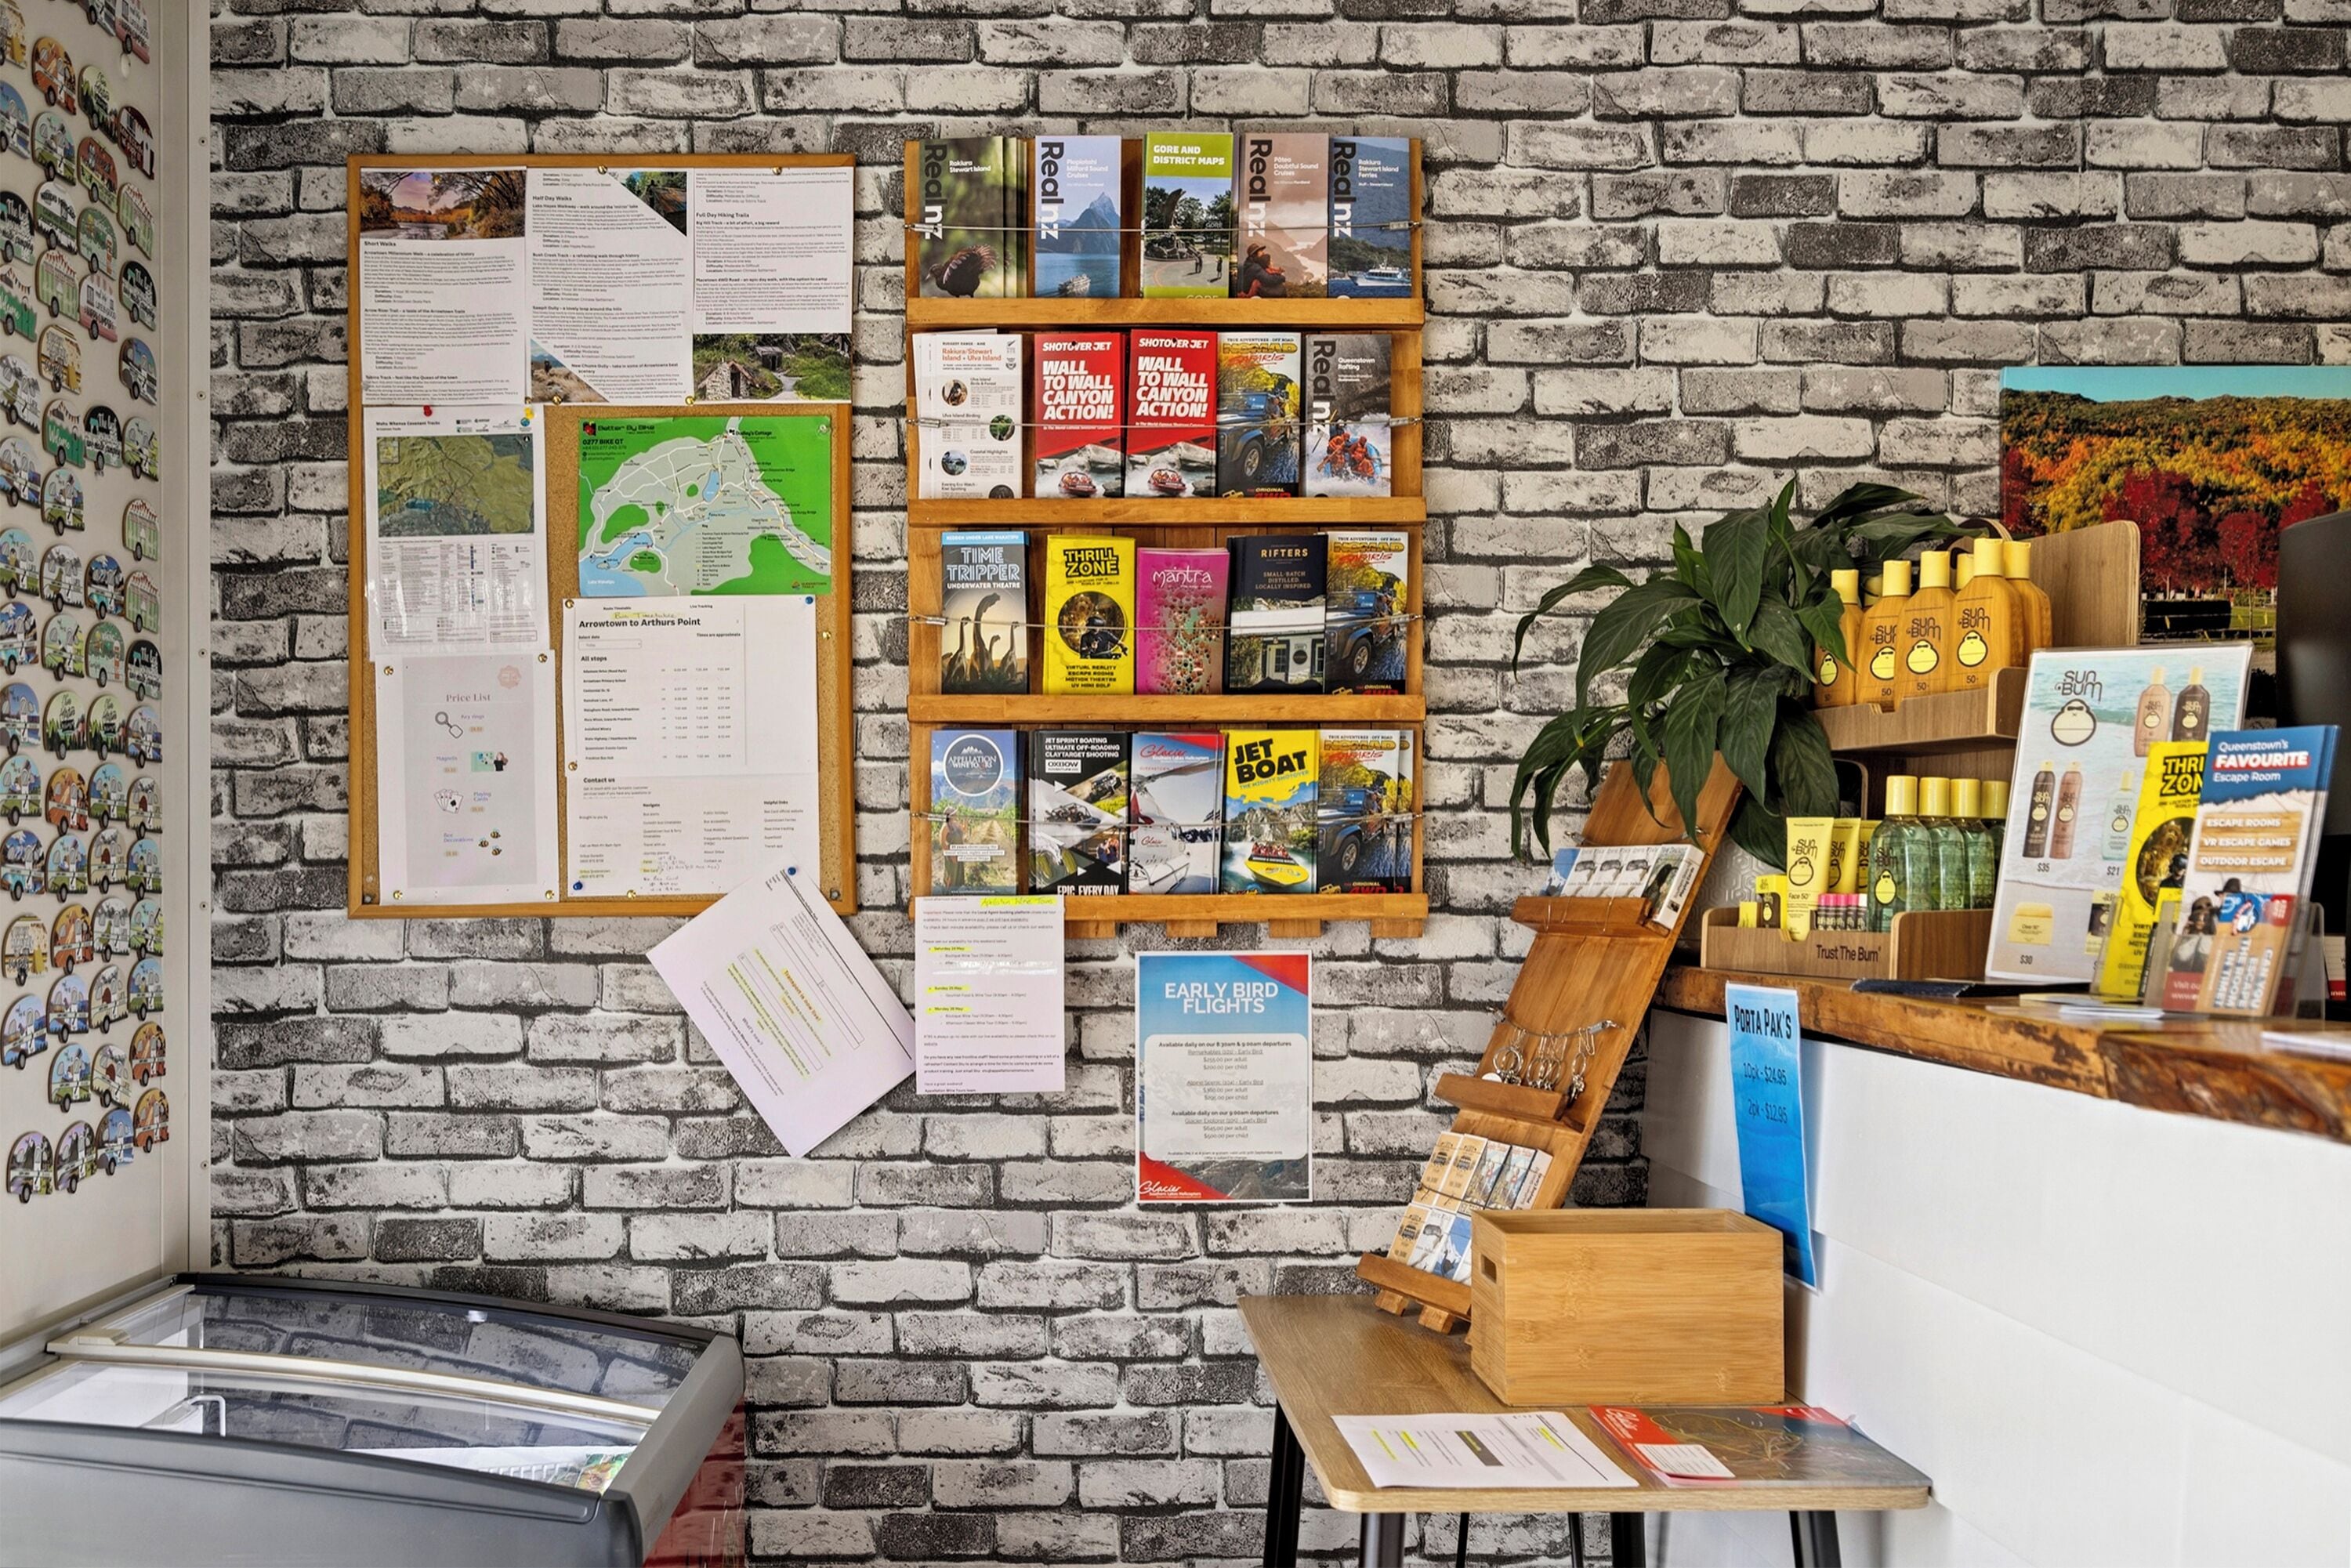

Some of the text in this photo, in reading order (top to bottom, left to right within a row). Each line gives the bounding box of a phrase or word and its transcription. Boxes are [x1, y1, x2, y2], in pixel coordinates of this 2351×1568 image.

[1154, 145, 1201, 154] GORE AND
[1153, 156, 1196, 165] DISTRICT
[1042, 342, 1111, 351] SHOTOVER JET
[1139, 338, 1208, 349] SHOTOVER JET
[1223, 343, 1298, 354] NOMAD
[1042, 360, 1089, 375] WALL
[1138, 357, 1183, 372] WALL
[1043, 375, 1114, 389] TO WALL
[1138, 371, 1208, 387] TO WALL
[1042, 390, 1114, 405] CANYON
[1136, 387, 1208, 402] CANYON
[1043, 405, 1114, 419] ACTION!
[1136, 402, 1208, 418] ACTION!
[1261, 548, 1309, 559] RIFTERS
[1333, 542, 1404, 552] NOMAD
[961, 547, 1004, 564] TIME
[1065, 549, 1118, 562] THRILL
[947, 564, 1020, 581] TRIPPER
[1067, 561, 1118, 576] ZONE
[1153, 566, 1212, 587] mantra
[578, 619, 628, 628] Arrowtown
[640, 618, 676, 627] Arthurs
[677, 617, 701, 626] Point
[473, 693, 491, 702] List
[1140, 743, 1187, 758] Glacier
[1234, 738, 1274, 766] JET
[1324, 740, 1396, 751] NOMAD
[2218, 740, 2288, 751] Queenstown's
[2215, 752, 2309, 767] FAVOURITE
[1237, 751, 1307, 784] BOAT
[1252, 777, 1275, 788] MIGHTY
[2213, 772, 2280, 784] Escape Room
[2207, 818, 2281, 828] ESCAPE ROOMS
[2257, 838, 2291, 846] GAMES
[2037, 862, 2050, 873] $35
[2201, 856, 2287, 866] OUTDOOR ESCAPE
[2106, 866, 2120, 876] $21
[1078, 885, 1119, 895] EVERY DAY
[1817, 944, 1878, 962] Trust The Bum
[2020, 955, 2033, 965] $30
[1165, 983, 1279, 999] EARLY BIRD
[1183, 998, 1265, 1014] FLIGHTS
[1734, 1005, 1791, 1039] PORTA PAK'S
[1744, 1063, 1787, 1085] 10pk $24.95
[1748, 1099, 1788, 1124] 2pk $12.95
[1139, 1180, 1181, 1194] Glacier
